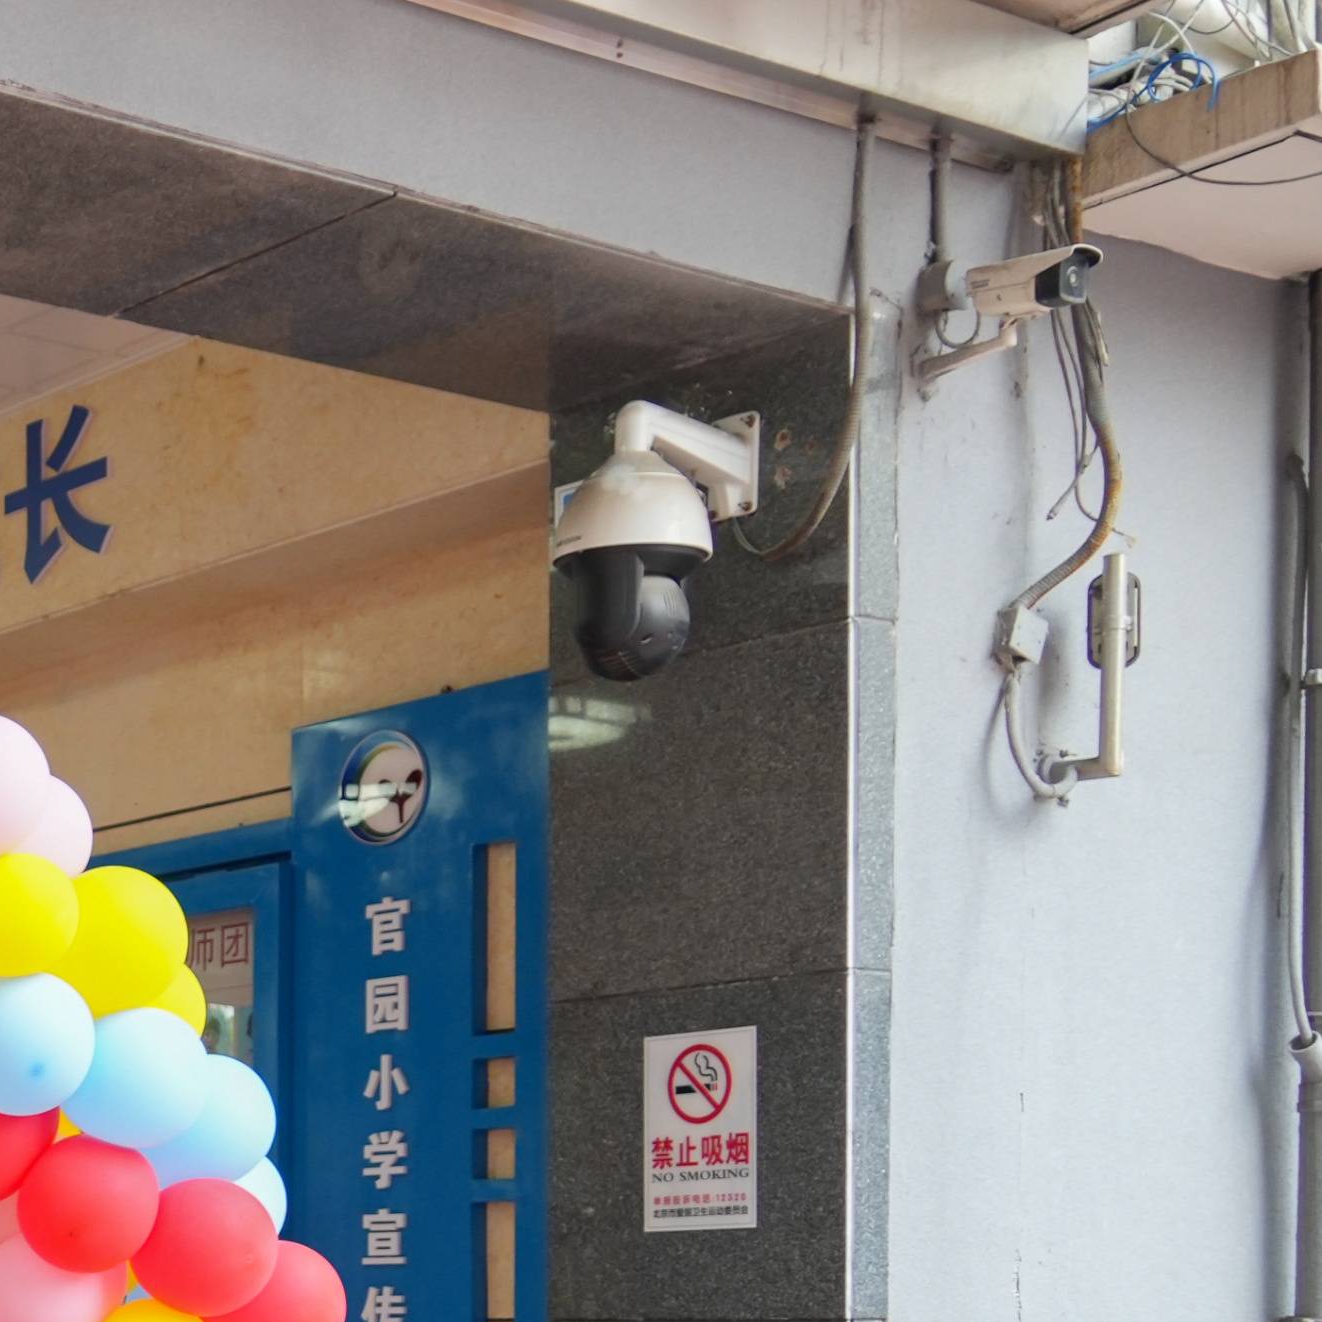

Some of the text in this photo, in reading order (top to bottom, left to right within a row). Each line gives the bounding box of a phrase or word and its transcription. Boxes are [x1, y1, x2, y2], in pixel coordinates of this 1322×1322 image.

[652, 1132, 749, 1169] 禁止吸烟
[652, 1168, 749, 1183] NO SMOKING
